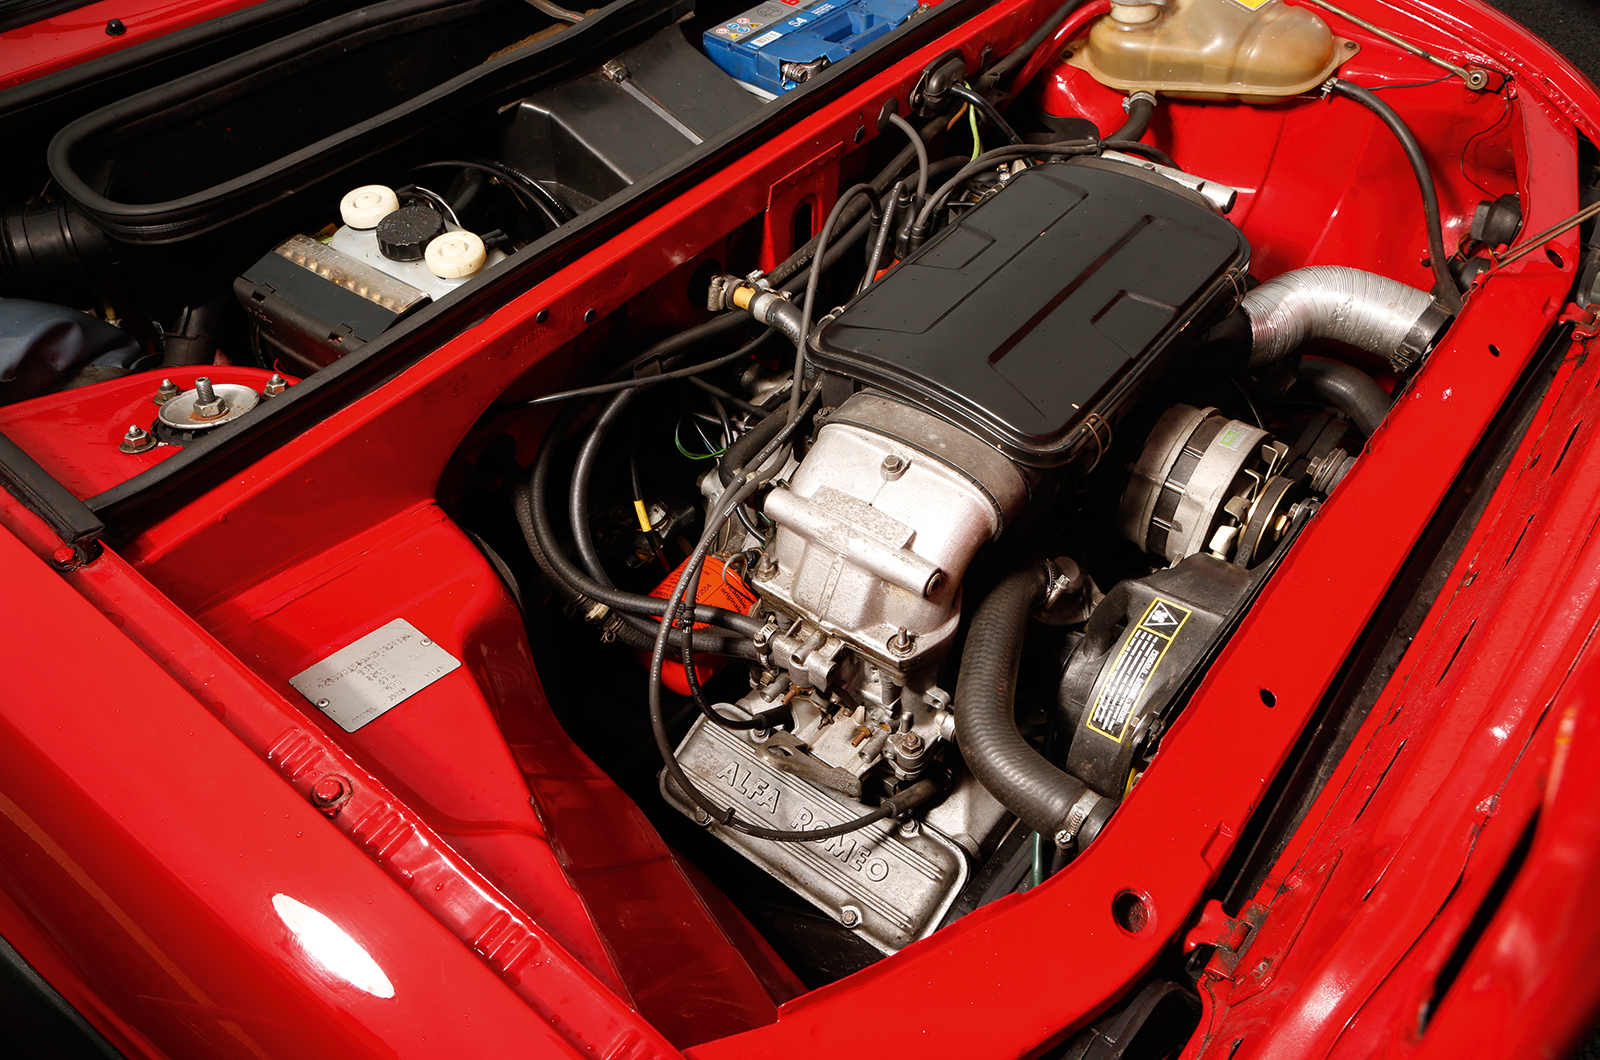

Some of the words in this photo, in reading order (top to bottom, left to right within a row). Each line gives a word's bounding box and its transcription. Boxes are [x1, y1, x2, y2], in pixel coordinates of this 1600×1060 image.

[788, 17, 807, 27] S4
[795, 255, 808, 267] FOR
[721, 588, 742, 613] originale
[725, 584, 747, 609] ricambio
[716, 761, 780, 814] ALFA
